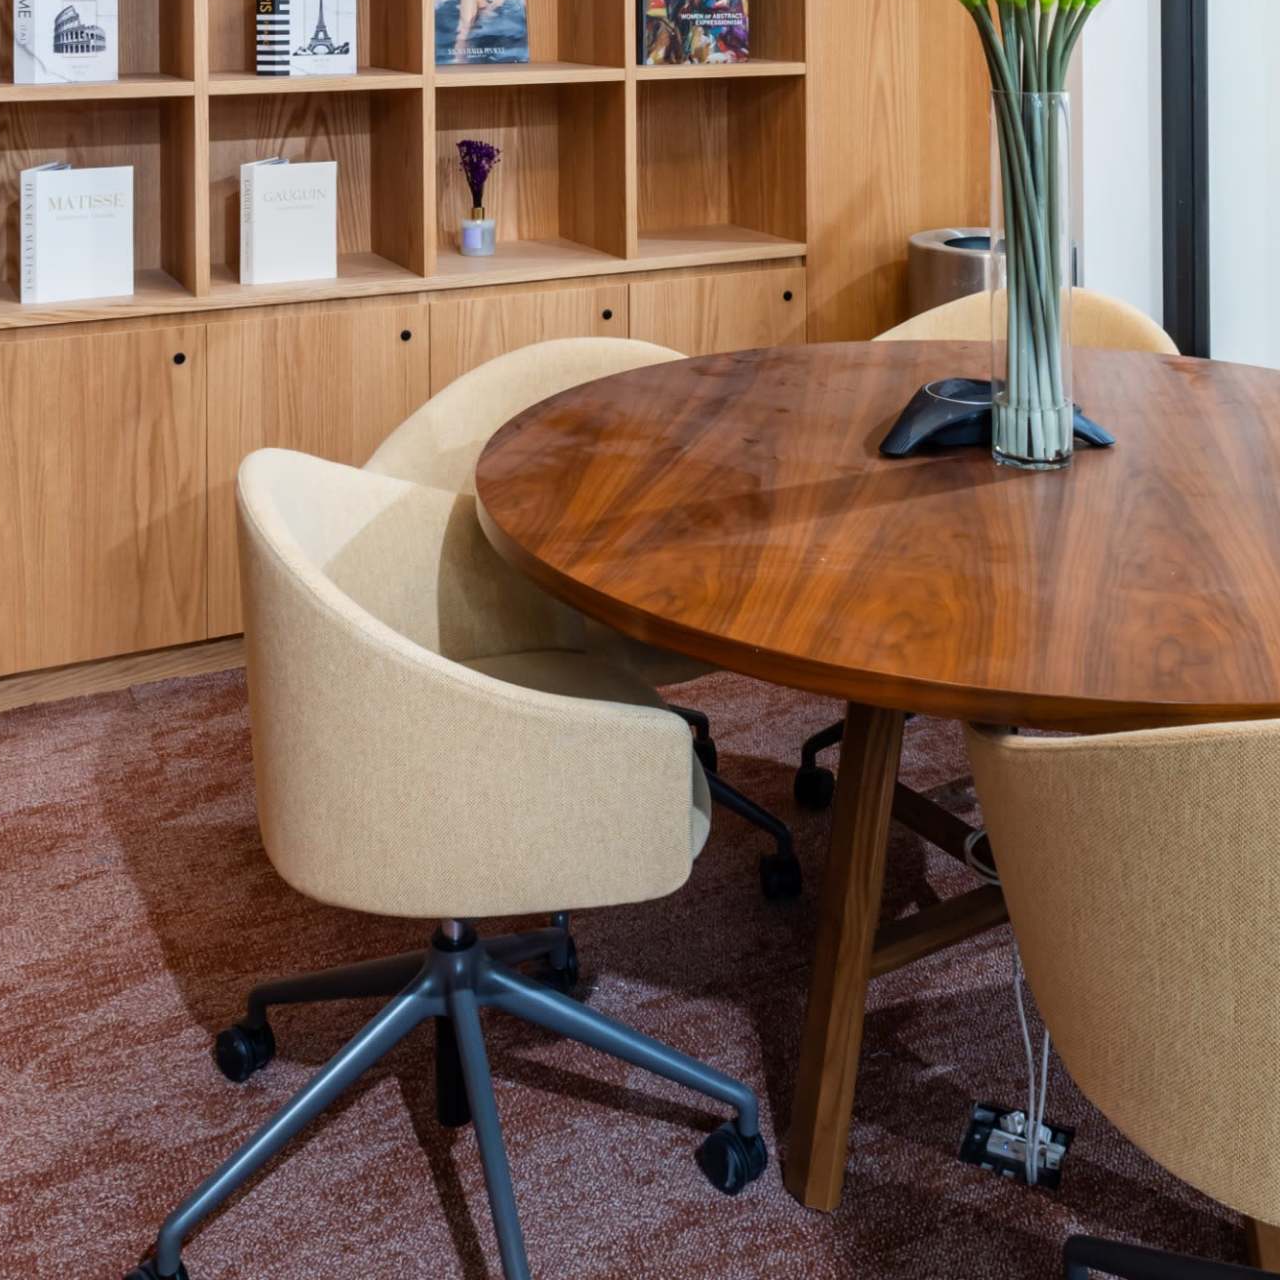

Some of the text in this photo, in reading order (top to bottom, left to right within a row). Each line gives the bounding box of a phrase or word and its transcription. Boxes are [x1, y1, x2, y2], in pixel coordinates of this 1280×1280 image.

[48, 192, 126, 211] MATISSE
[263, 187, 327, 202] GAUGUIN
[23, 183, 33, 293] HENRI MATISSE
